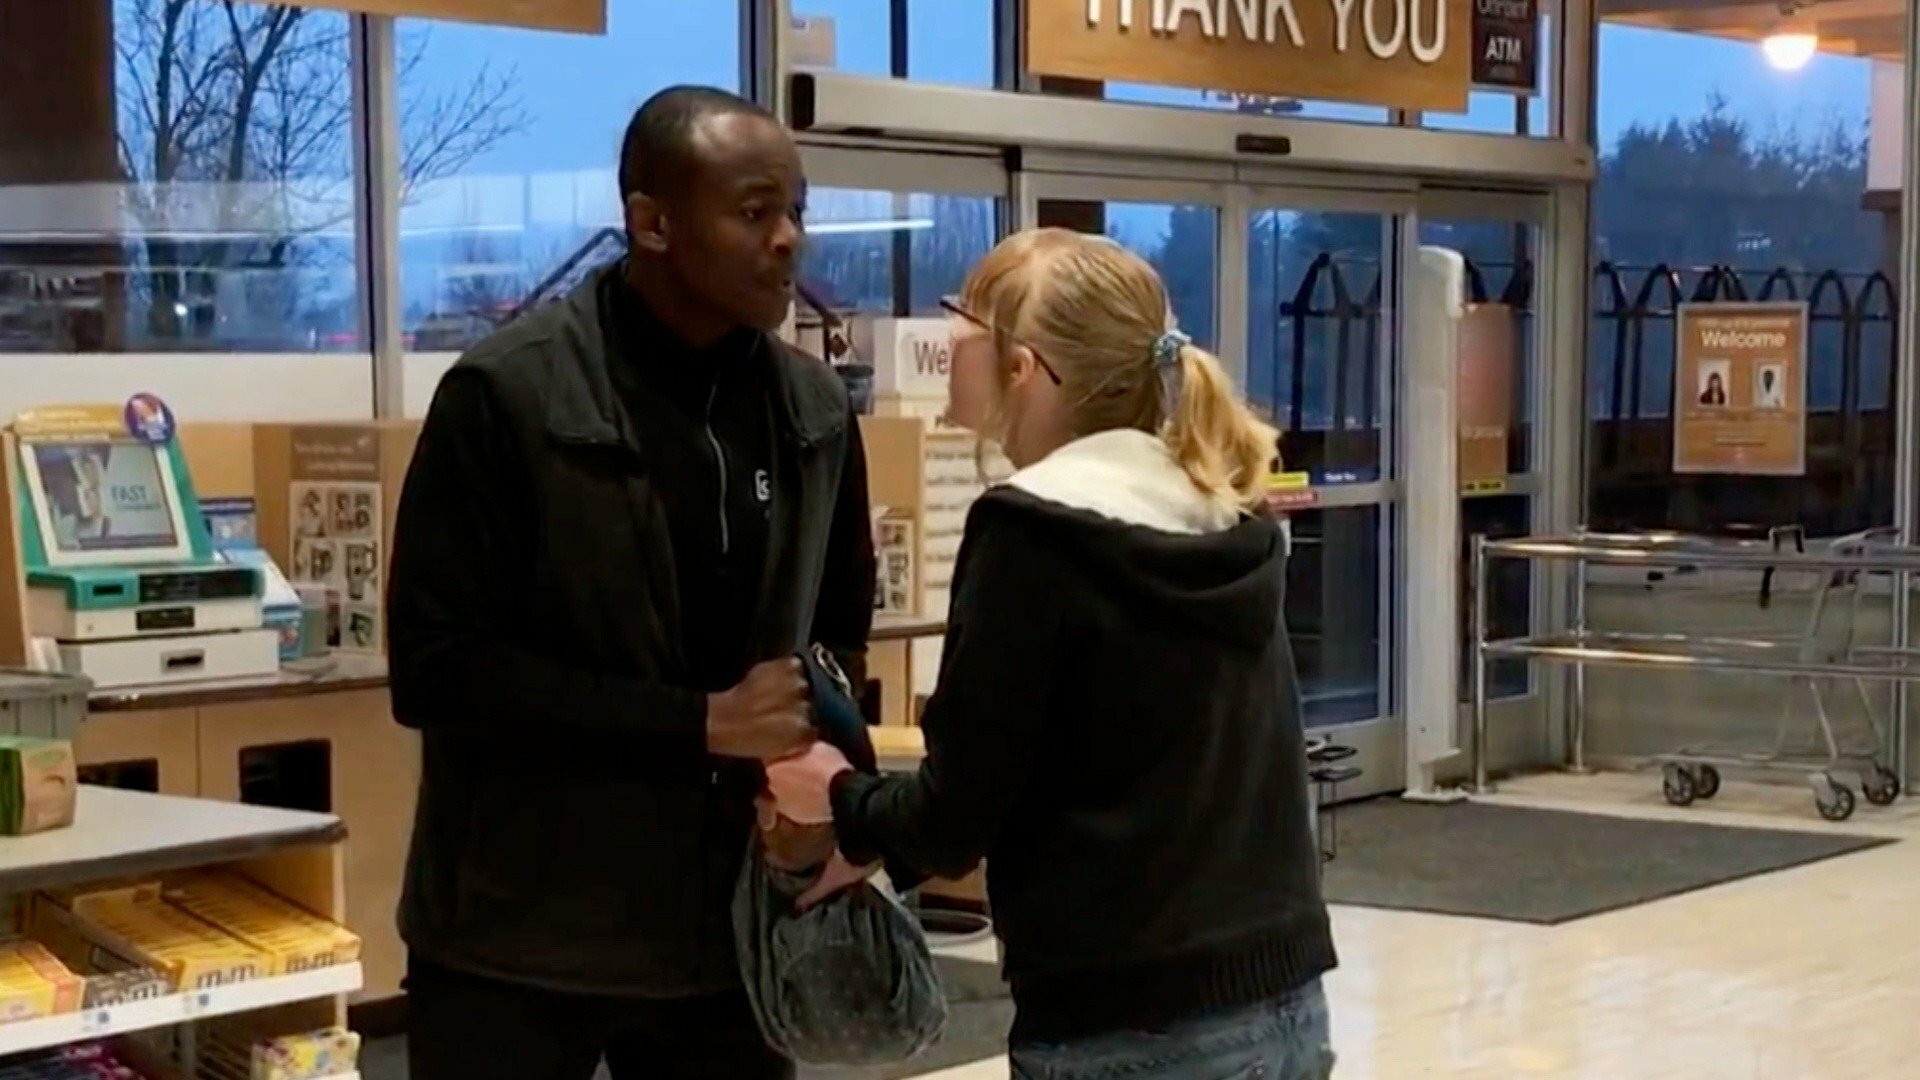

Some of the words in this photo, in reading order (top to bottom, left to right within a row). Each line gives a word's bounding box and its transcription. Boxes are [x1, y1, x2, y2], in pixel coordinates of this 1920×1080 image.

[1333, 0, 1446, 62] YOU
[1485, 35, 1521, 62] ATM
[1700, 330, 1786, 349] Welcome
[913, 340, 950, 375] We
[111, 485, 147, 501] FAST
